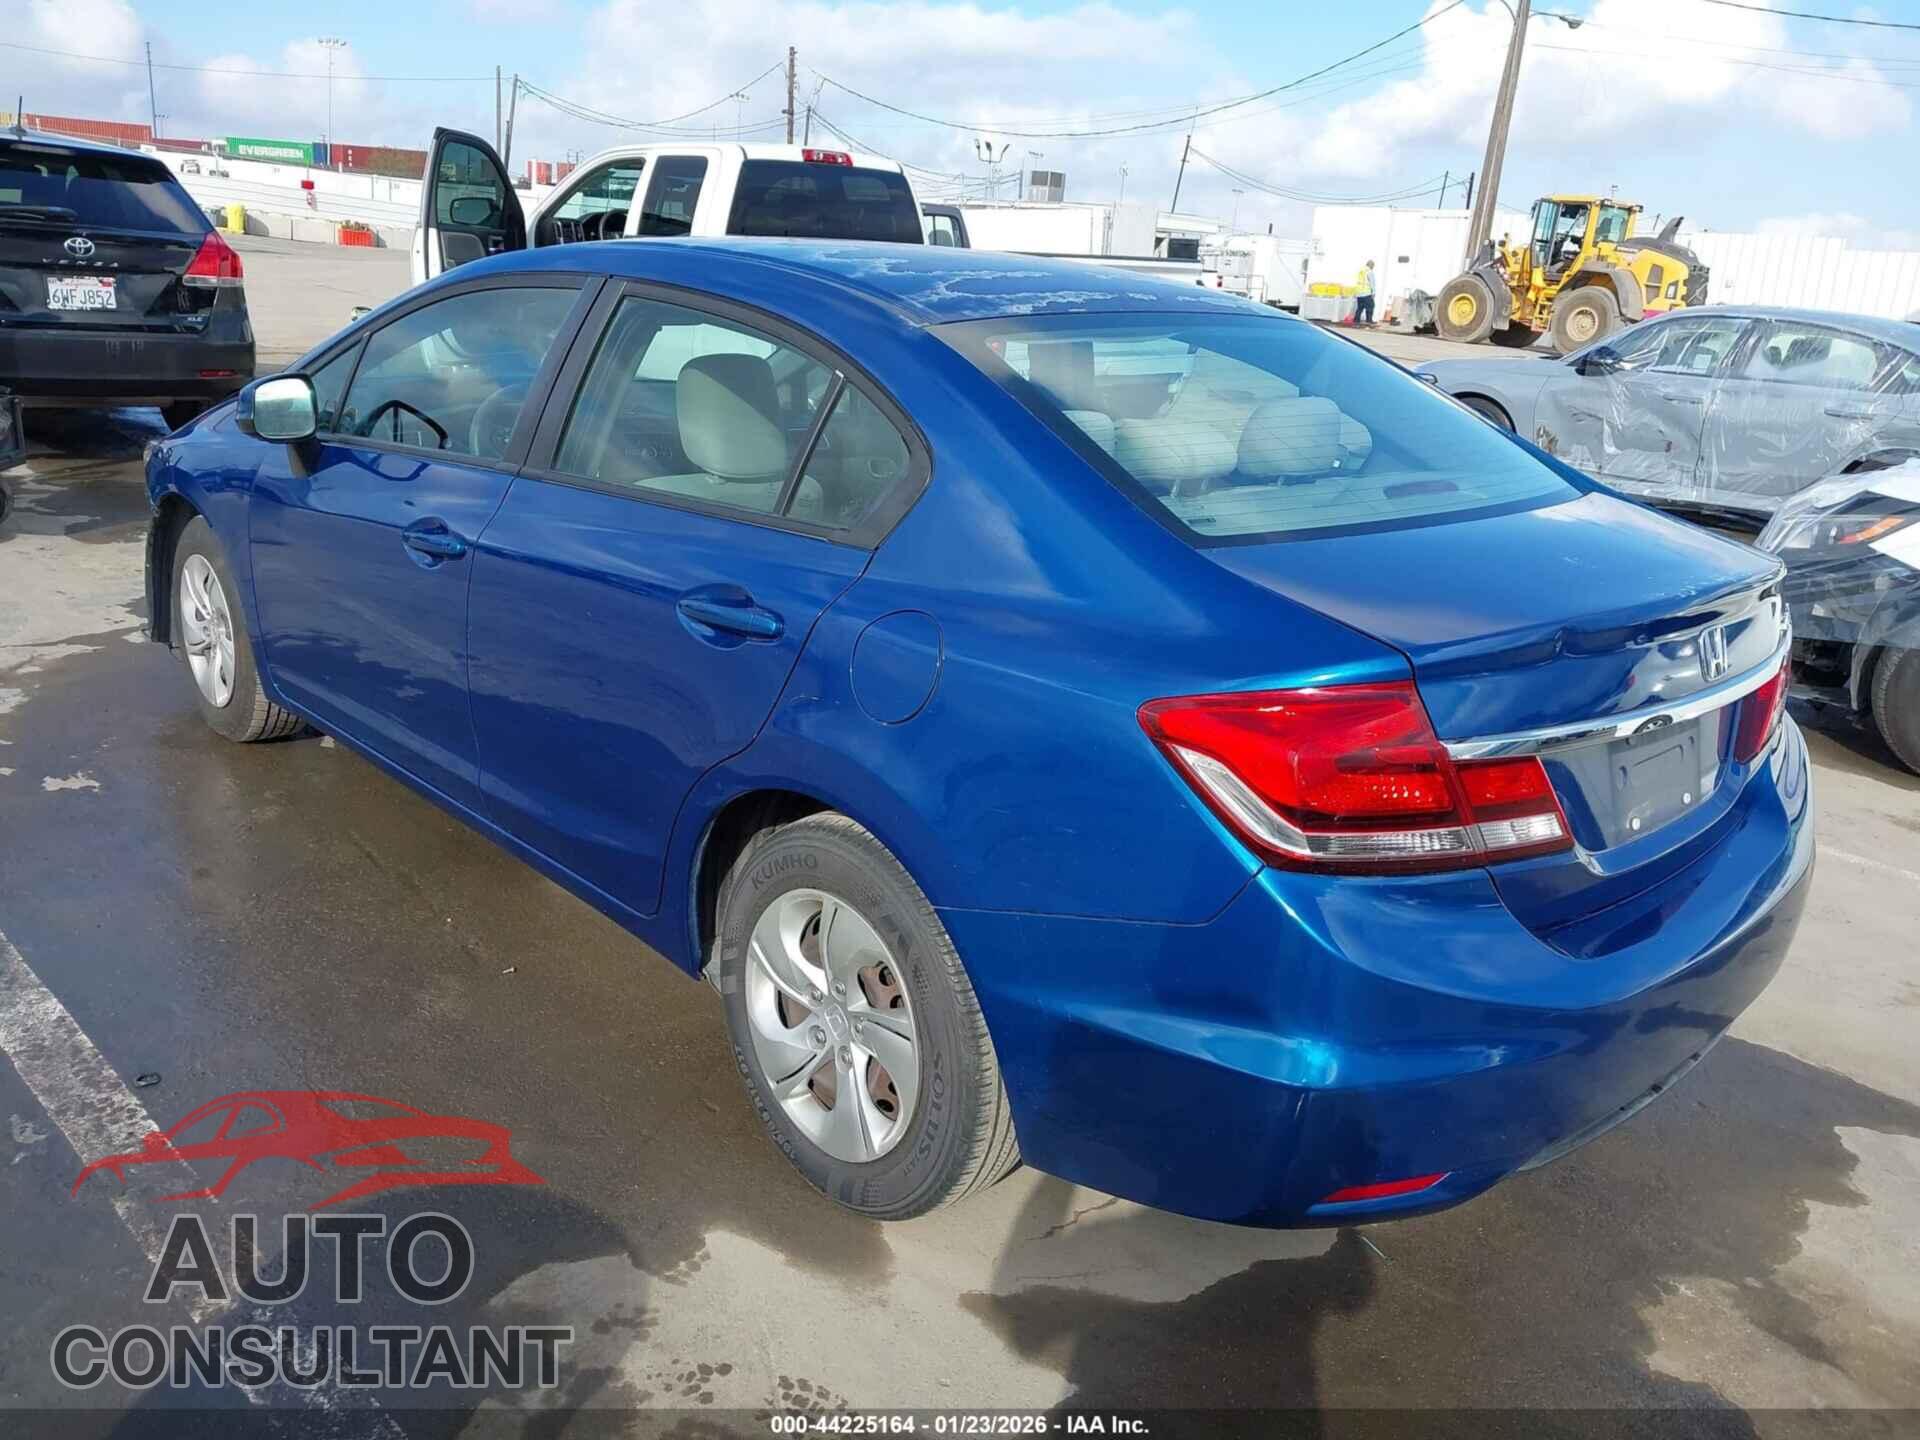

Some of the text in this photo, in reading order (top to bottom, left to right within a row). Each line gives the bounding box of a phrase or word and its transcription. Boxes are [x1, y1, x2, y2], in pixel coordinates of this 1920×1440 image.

[238, 144, 304, 159] EVERGREEN
[52, 288, 114, 306] 6WFJ852
[751, 853, 818, 891] KUMHO
[919, 1051, 945, 1158] SOLUS
